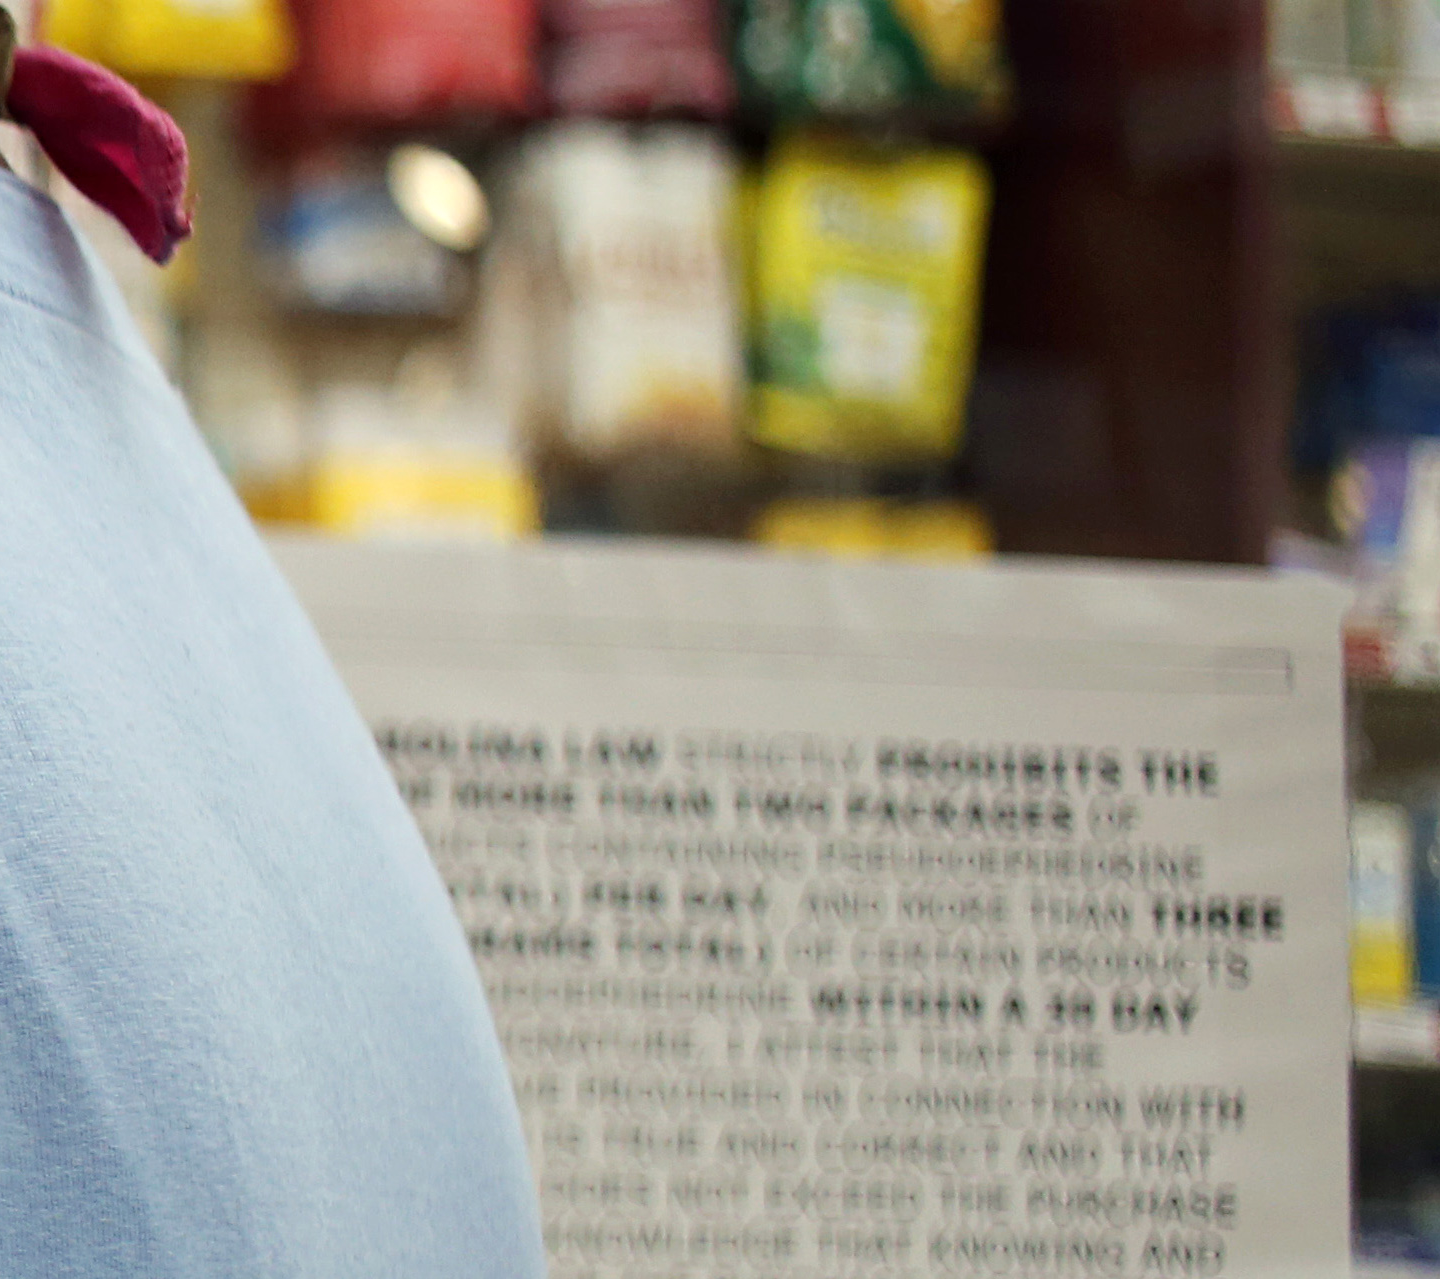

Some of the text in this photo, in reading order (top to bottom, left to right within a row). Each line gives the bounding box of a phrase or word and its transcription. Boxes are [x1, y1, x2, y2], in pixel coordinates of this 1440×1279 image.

[564, 730, 664, 773] LAW
[875, 741, 1126, 790] PROHIBITS
[1136, 750, 1223, 795] THE
[453, 775, 581, 819] MORE
[593, 777, 717, 824] THAN
[728, 783, 834, 826] TWO
[846, 789, 1077, 834] PACKAGES
[1087, 798, 1145, 837] OF
[585, 876, 668, 918] PER
[801, 883, 886, 926] AND
[898, 887, 1010, 929] MORE
[1028, 892, 1135, 933] THAN
[1147, 896, 1288, 941] THREE
[787, 934, 843, 975] OF
[853, 935, 1024, 978] CERTAIN
[1039, 943, 1254, 988] PRODUCTS
[809, 981, 987, 1024] WITHIN
[1109, 992, 1200, 1031] DAY
[757, 1026, 903, 1070] ATTEST
[914, 1031, 1016, 1073] THAT
[1030, 1036, 1106, 1078] THE
[859, 1080, 1128, 1127] CONNECTION
[1140, 1087, 1249, 1131] WITH
[719, 1124, 804, 1166] AND
[817, 1126, 1004, 1170] CORRECT
[1020, 1130, 1104, 1174] AND
[1118, 1135, 1217, 1177] THAT
[766, 1174, 923, 1218] EXCEED
[936, 1176, 1016, 1221] THE
[1026, 1179, 1241, 1229] PURCHASE
[817, 1223, 917, 1265] THAT
[928, 1226, 1129, 1275] KNOWING
[1143, 1231, 1227, 1275] AND
